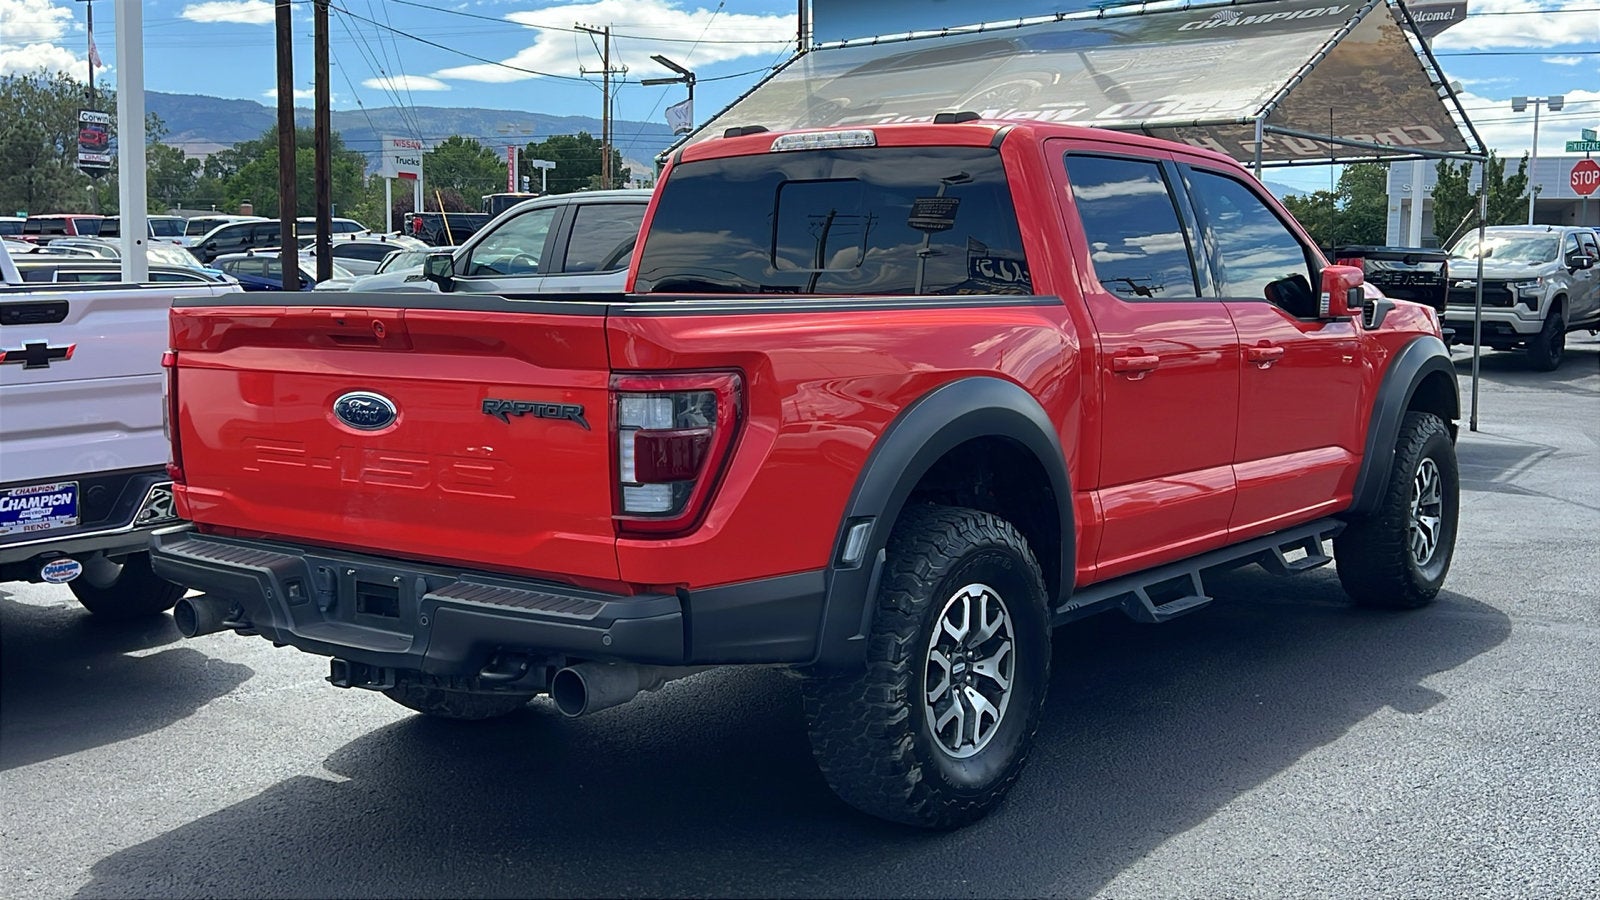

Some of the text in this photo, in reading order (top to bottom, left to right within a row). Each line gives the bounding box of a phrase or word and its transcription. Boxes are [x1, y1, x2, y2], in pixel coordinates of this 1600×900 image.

[1178, 5, 1350, 31] CHAMPION
[1401, 8, 1456, 23] Welcome!
[82, 112, 109, 123] Corwin
[393, 139, 421, 150] NISSAN
[1573, 141, 1600, 151] KIETZKE
[394, 155, 420, 166] Trucks
[1571, 170, 1600, 186] STOP
[344, 399, 381, 423] Ford
[482, 399, 591, 430] RAPTOR
[15, 485, 56, 495] CHAMPION
[0, 493, 72, 512] CHAMPION
[23, 522, 51, 532] RENO
